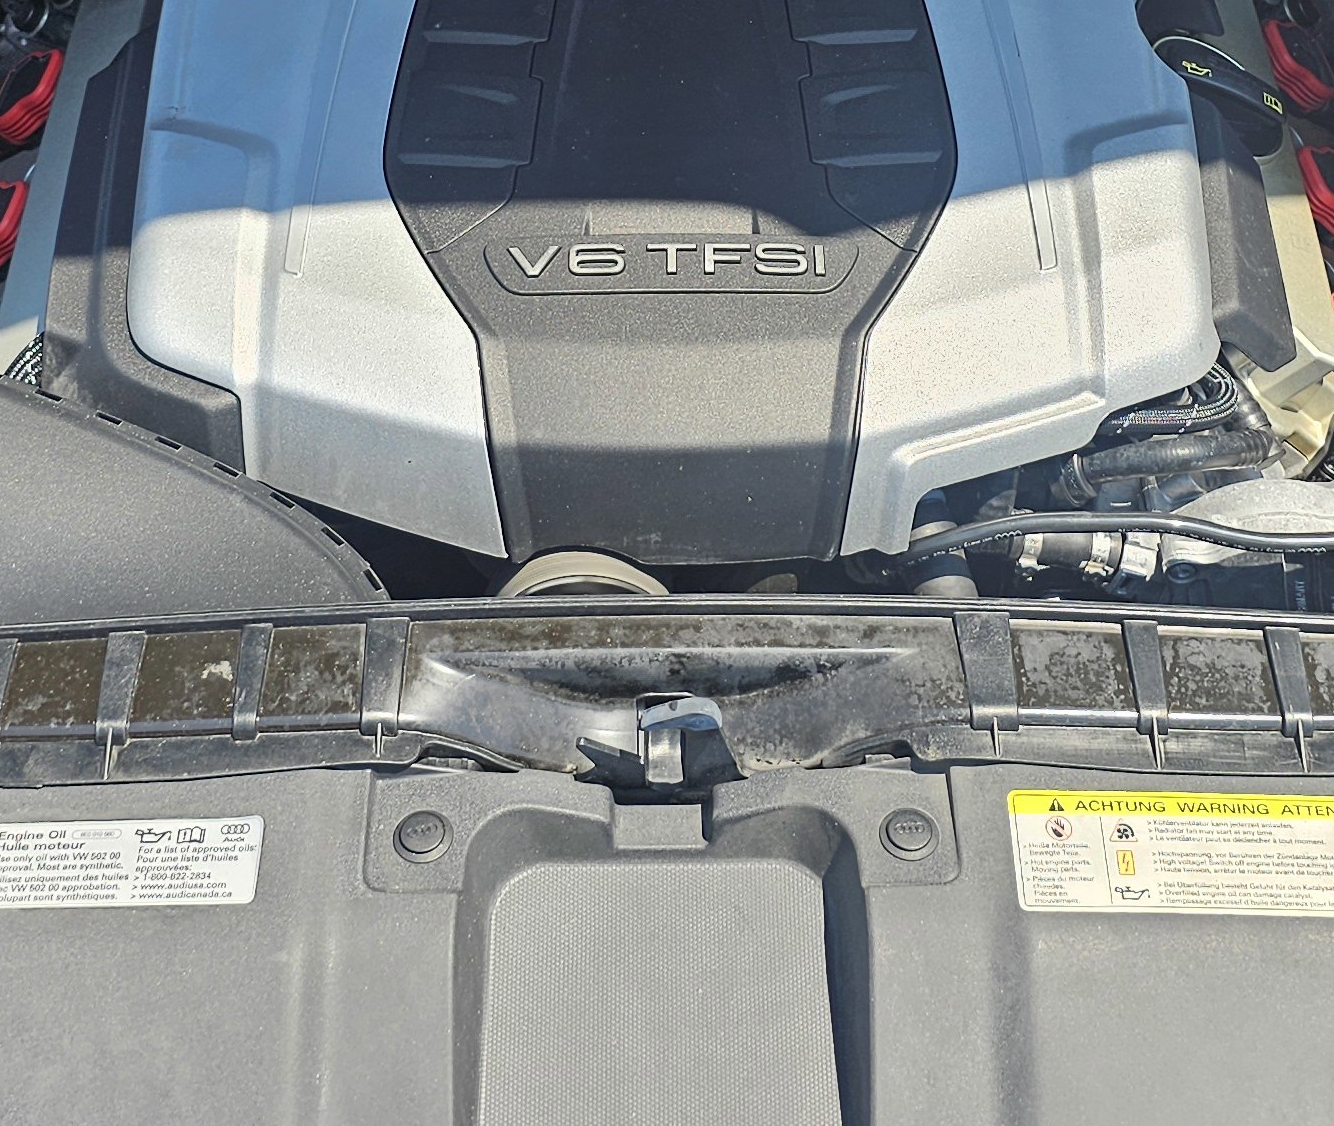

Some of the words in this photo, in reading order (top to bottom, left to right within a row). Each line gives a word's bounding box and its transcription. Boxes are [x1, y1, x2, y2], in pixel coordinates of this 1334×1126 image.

[507, 243, 626, 279] V6
[646, 243, 826, 277] TFSI
[1074, 801, 1166, 813] ACHTUNG
[1177, 802, 1269, 814] WARNING
[49, 830, 66, 839] Oil
[34, 841, 86, 850] moteur
[138, 846, 154, 854] For
[164, 845, 178, 853] list
[180, 845, 190, 853] of
[192, 844, 236, 855] approved
[13, 853, 33, 863] only
[35, 853, 47, 862] oil
[50, 853, 69, 861] with
[73, 852, 89, 861] VW
[91, 852, 107, 861] 502
[110, 851, 121, 860] 00
[137, 855, 159, 863] Pour
[180, 853, 200, 862] liste
[202, 853, 239, 862] d'huiles
[37, 863, 60, 871] Most
[79, 861, 123, 872] synthetic.
[24, 874, 80, 884] uniquement
[83, 873, 99, 881] des
[101, 872, 129, 880] huiles
[11, 884, 28, 892] VW
[29, 884, 46, 892] 502
[48, 883, 60, 892] 00
[61, 882, 120, 893] approbation.
[141, 881, 227, 890] www.audiusa.com
[139, 890, 232, 899] www.audicanada.ca
